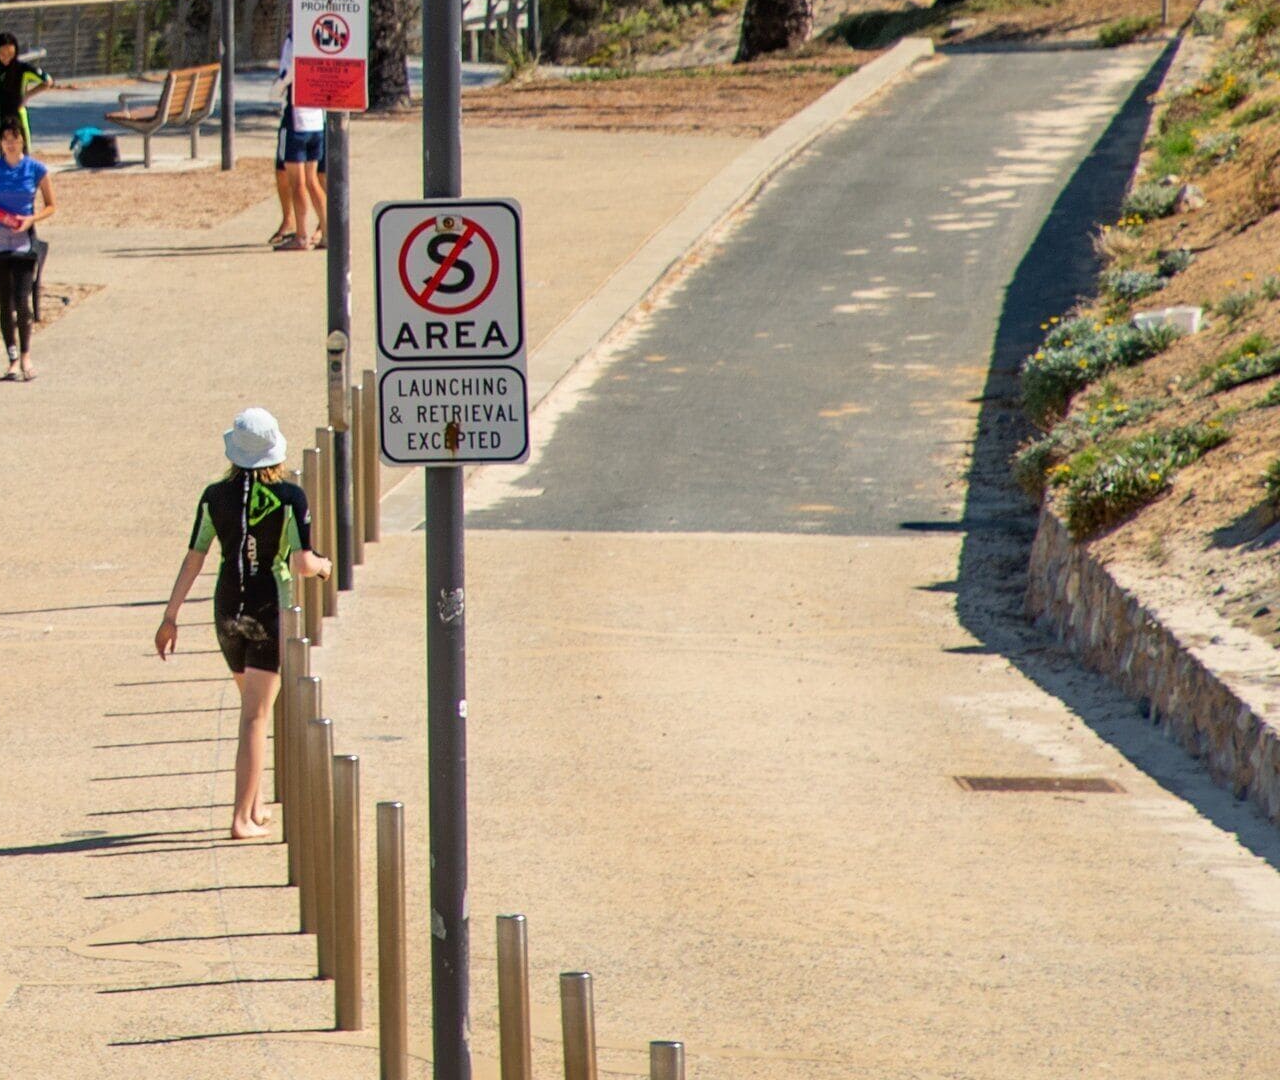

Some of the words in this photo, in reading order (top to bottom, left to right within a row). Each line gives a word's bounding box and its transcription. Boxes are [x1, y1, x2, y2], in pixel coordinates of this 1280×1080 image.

[300, 1, 361, 13] PROHIBITED
[422, 233, 476, 294] S
[393, 320, 509, 350] AREA
[397, 377, 508, 397] LAUNCHING
[388, 406, 403, 423] &
[417, 403, 519, 423] RETRIEVAL
